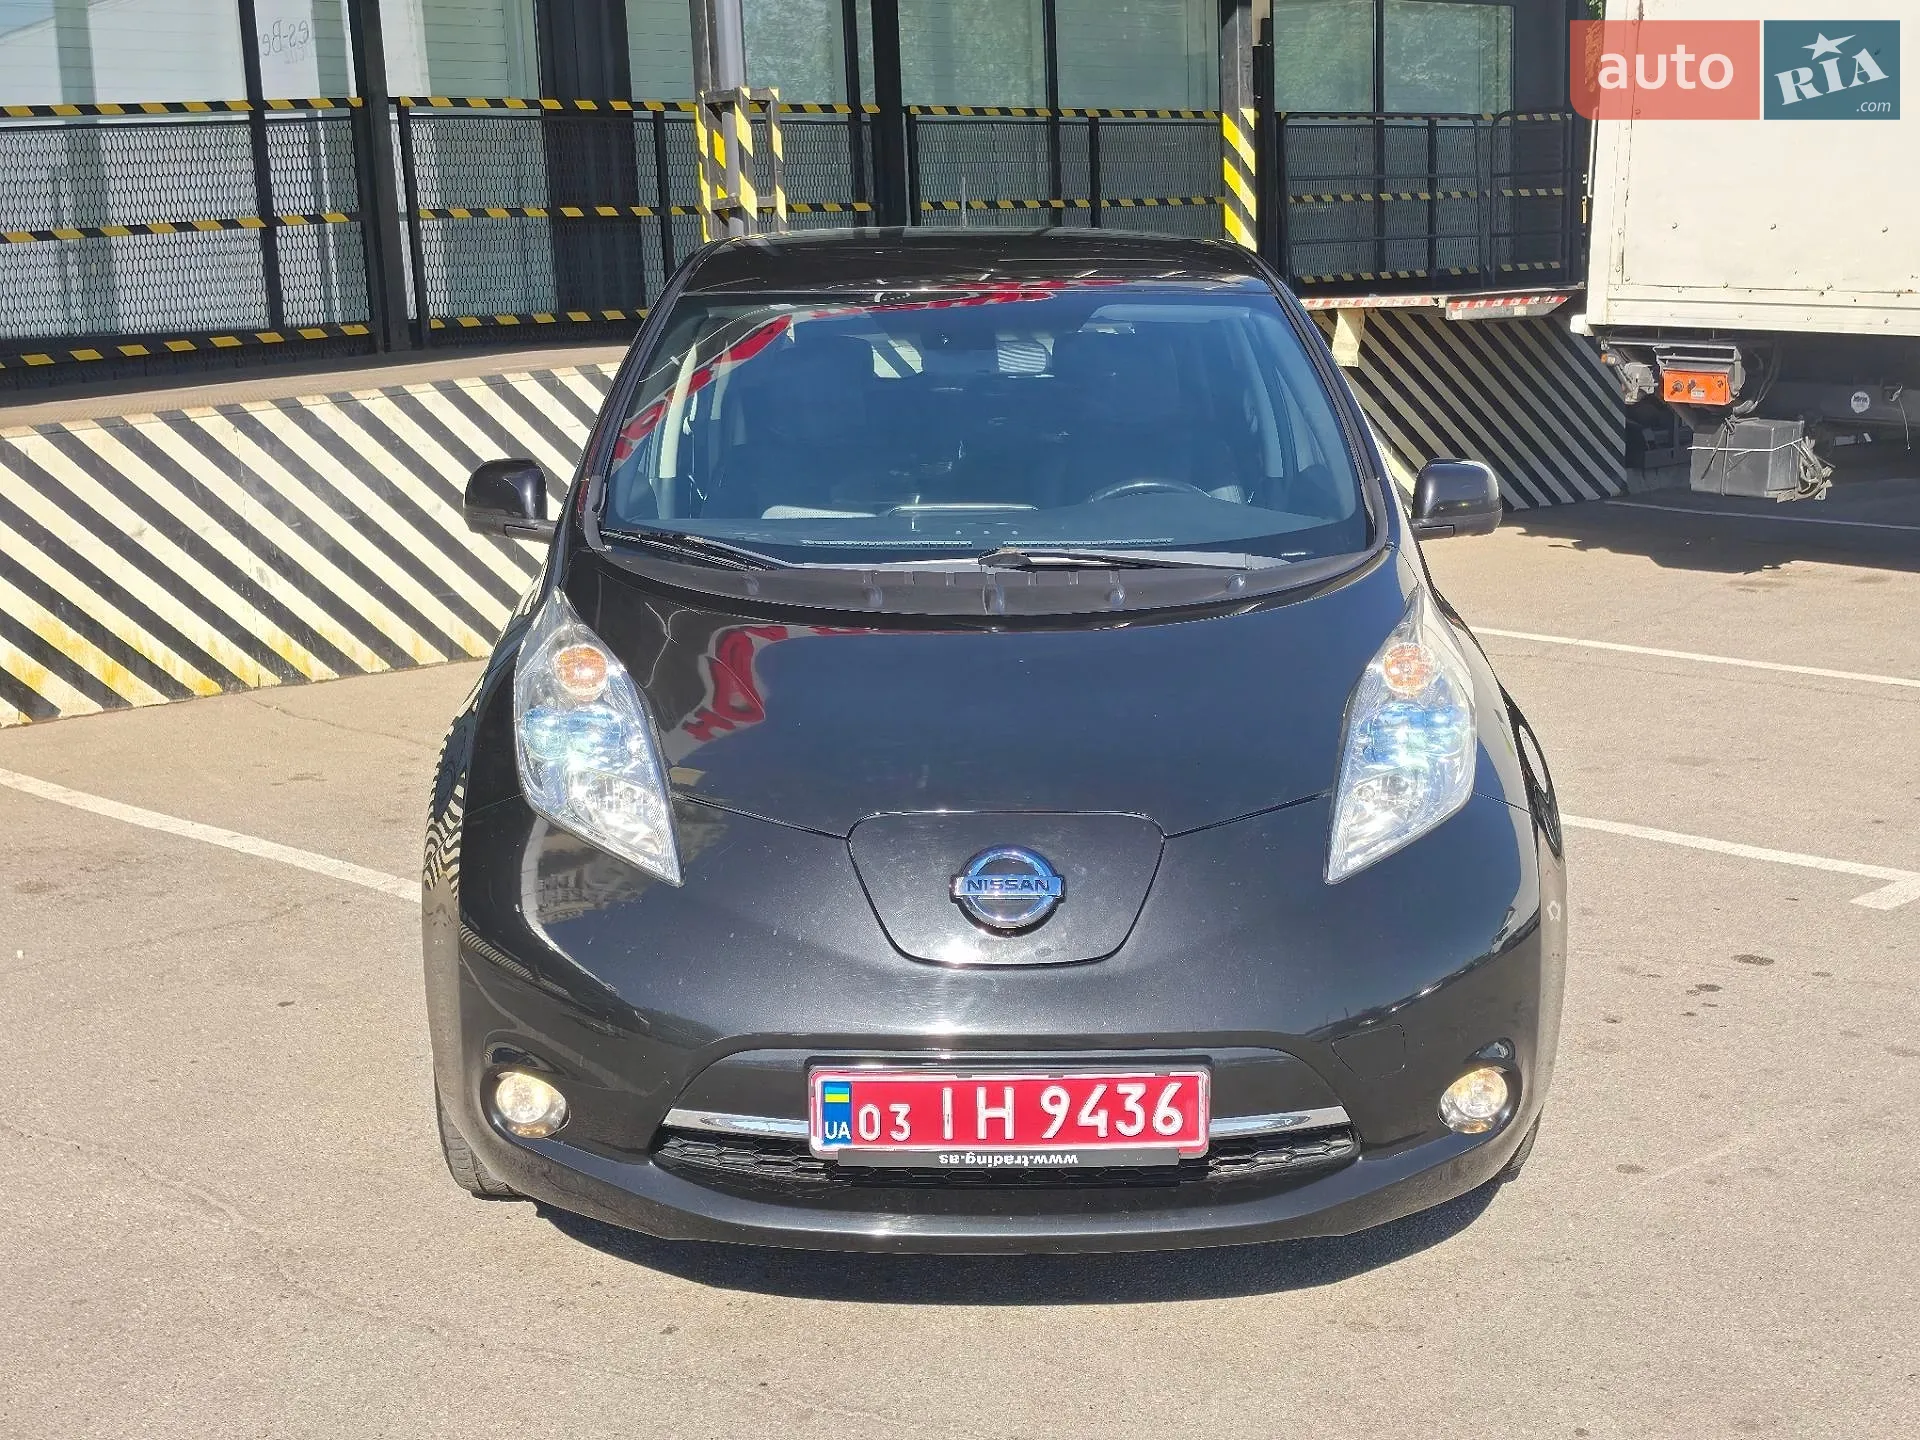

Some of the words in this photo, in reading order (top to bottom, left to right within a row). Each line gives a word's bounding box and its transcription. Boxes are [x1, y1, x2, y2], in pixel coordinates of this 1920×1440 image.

[966, 878, 1051, 892] NISSAN
[858, 1103, 912, 1141] 03
[942, 1086, 1015, 1141] IH
[1040, 1082, 1184, 1139] 9436
[824, 1121, 852, 1140] UA
[938, 1152, 1079, 1168] www.trading.as
